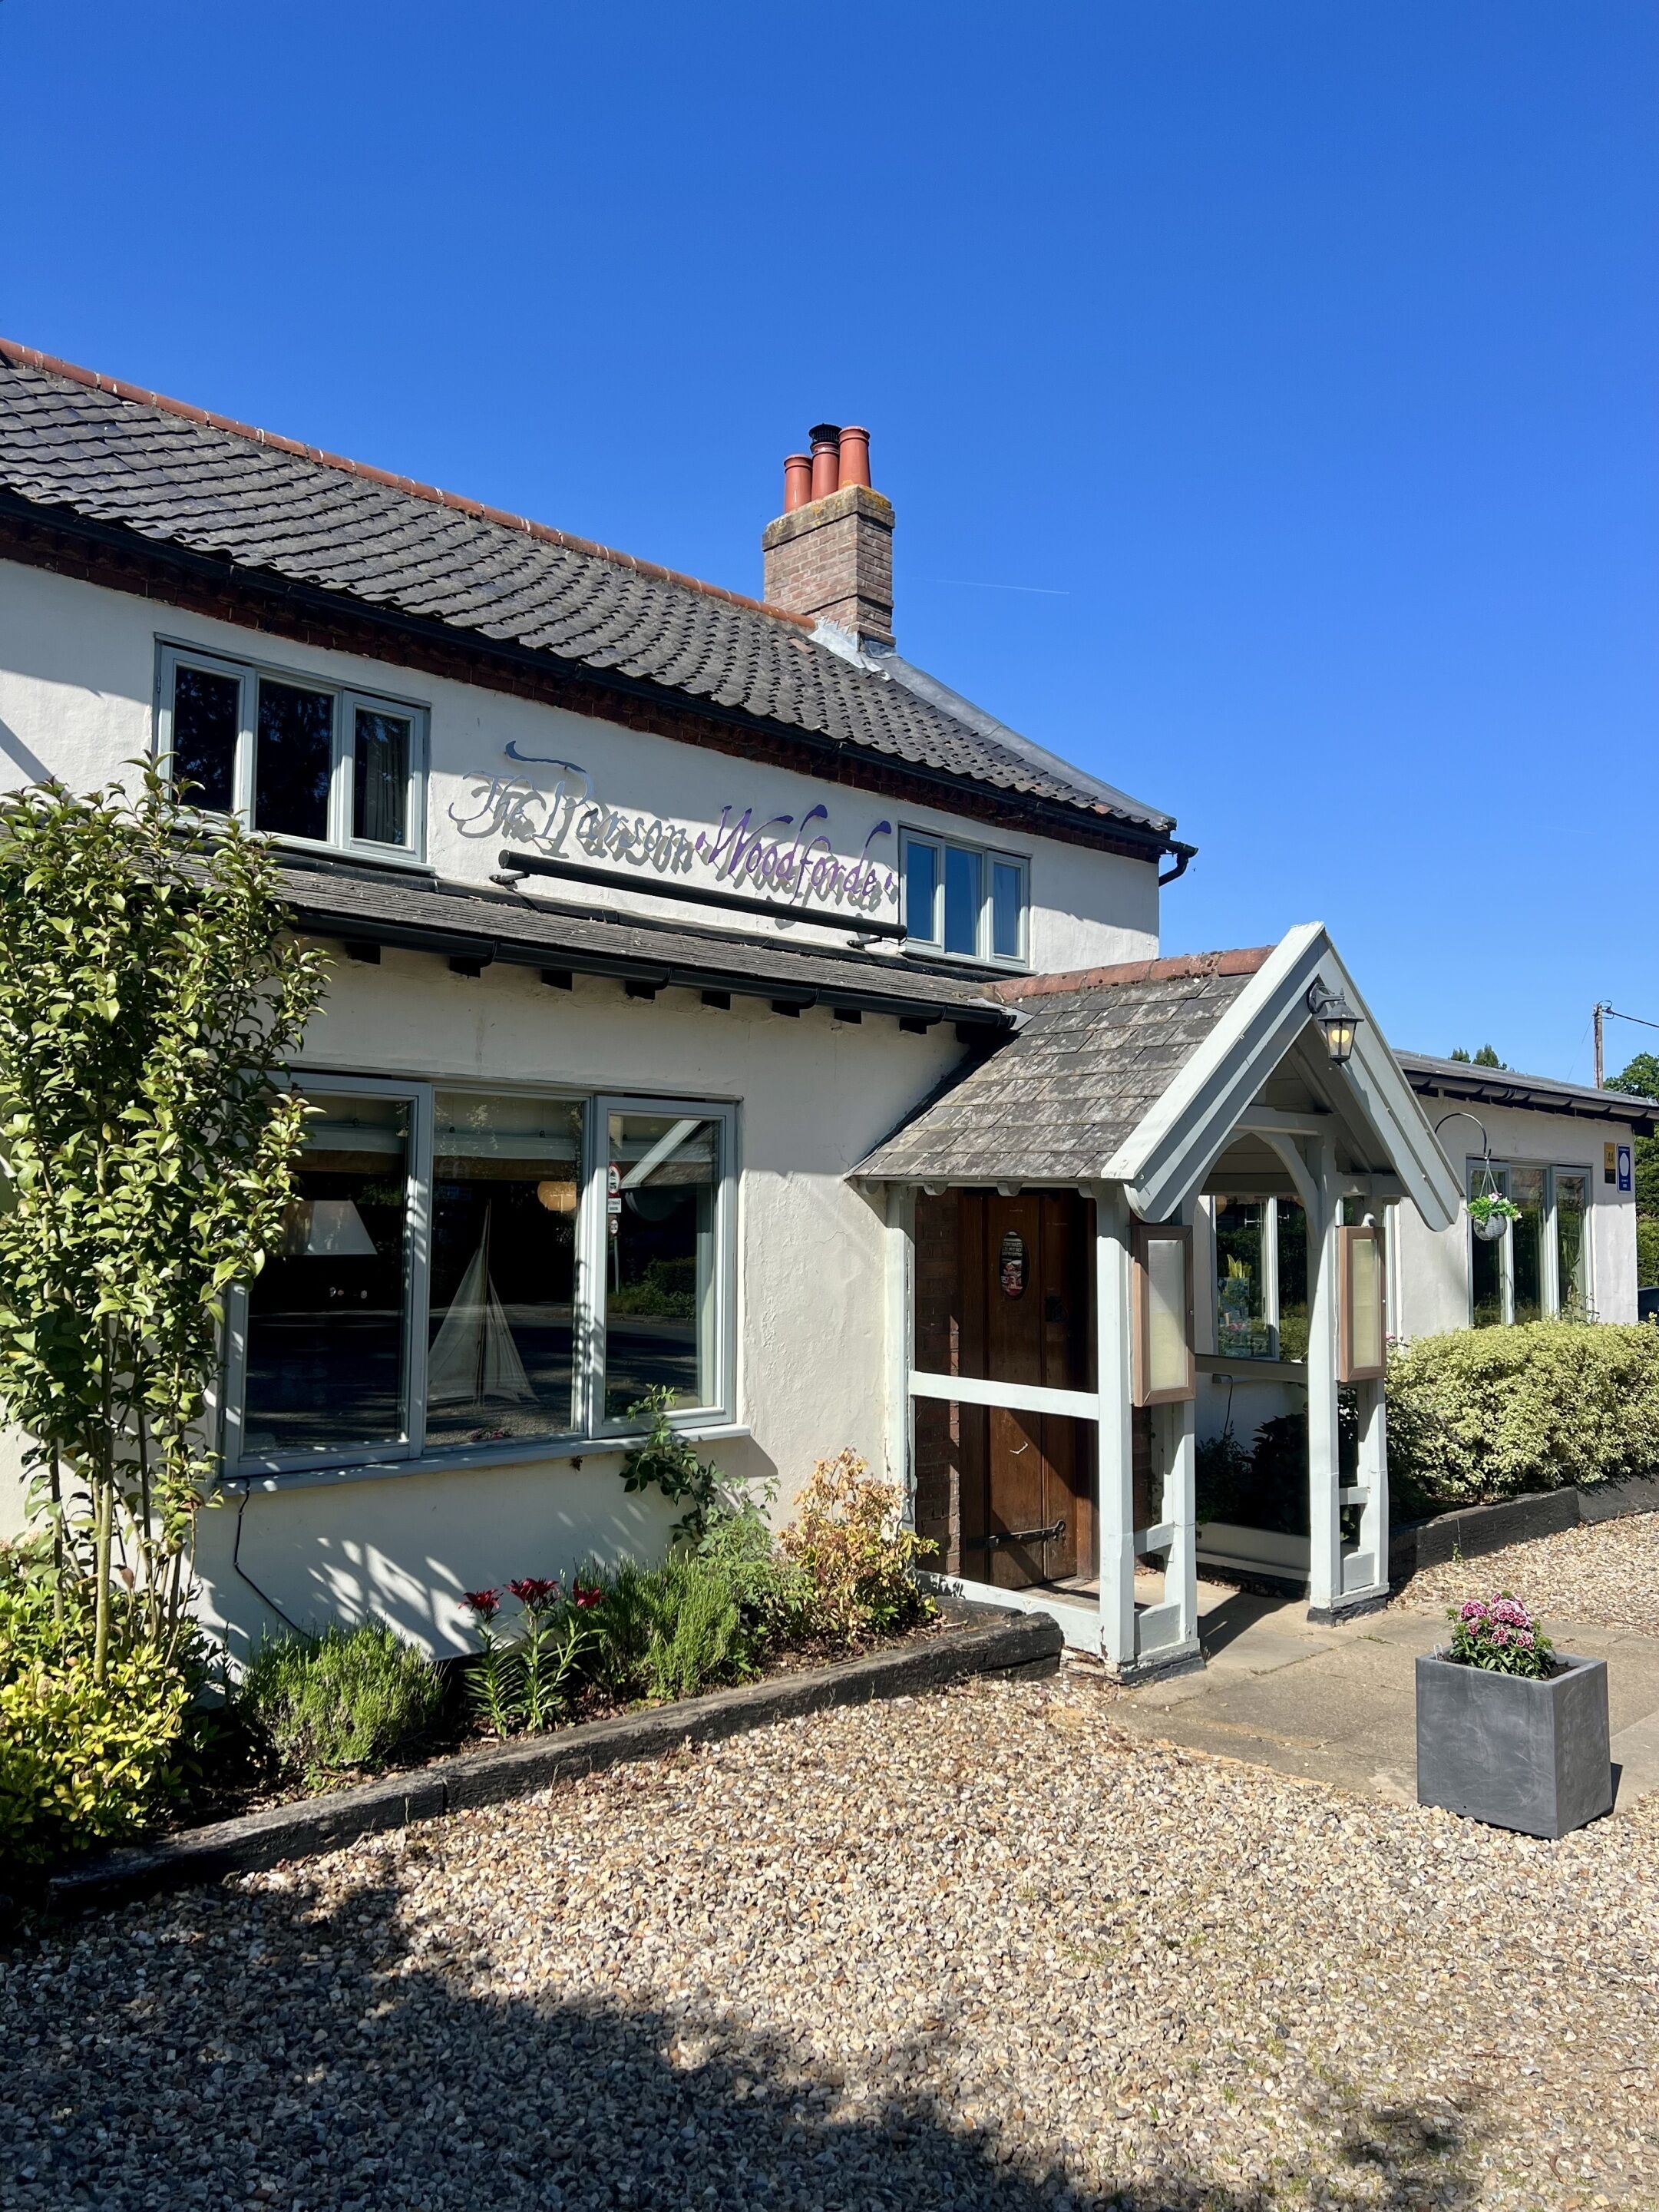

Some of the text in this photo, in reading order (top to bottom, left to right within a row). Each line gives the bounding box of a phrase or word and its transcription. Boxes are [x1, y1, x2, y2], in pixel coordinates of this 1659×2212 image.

[448, 740, 891, 905] The Parson Woodforde
